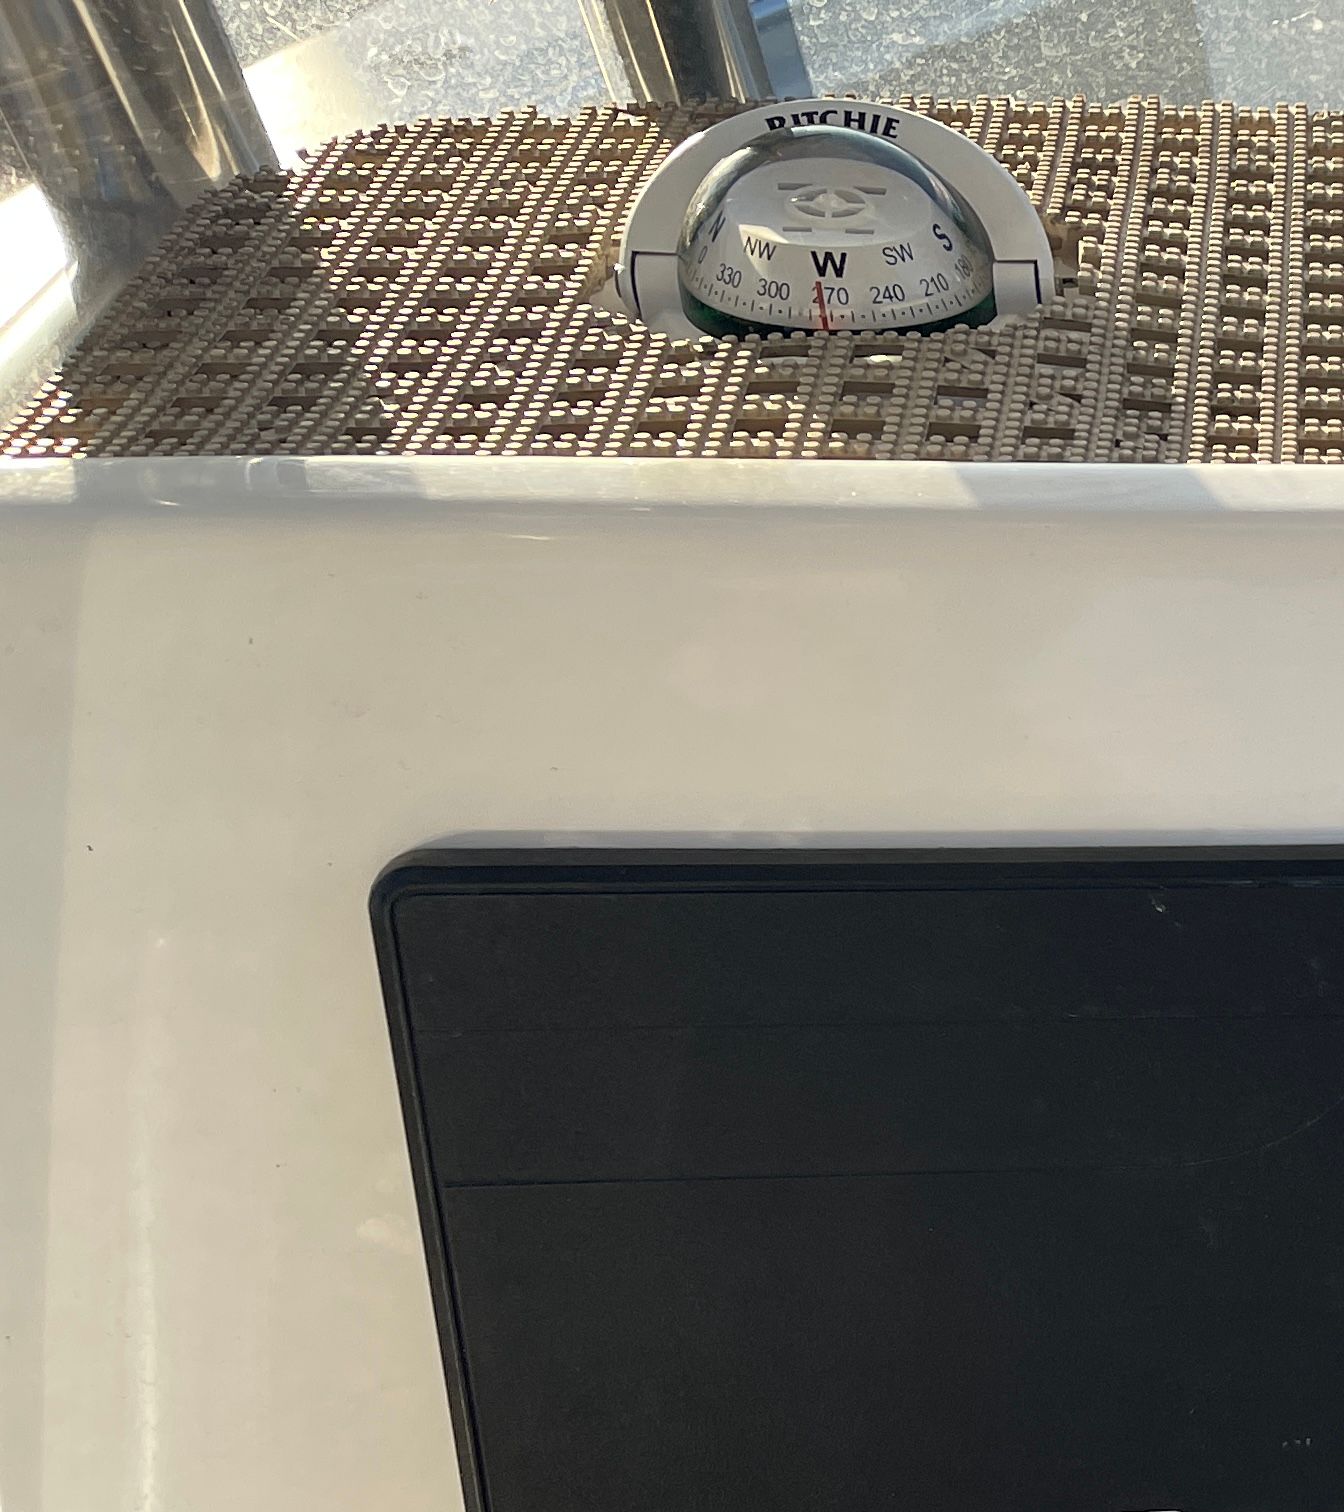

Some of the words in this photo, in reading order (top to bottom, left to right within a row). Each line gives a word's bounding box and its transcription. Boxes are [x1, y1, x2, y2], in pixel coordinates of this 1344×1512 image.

[765, 109, 900, 139] RITCHIE
[709, 211, 726, 244] N
[743, 236, 778, 262] NW
[810, 251, 847, 278] W
[881, 244, 914, 266] SW
[932, 223, 953, 251] S
[716, 263, 743, 289] 330
[757, 278, 791, 302] 300
[869, 284, 906, 305] 240
[918, 273, 950, 297] 210
